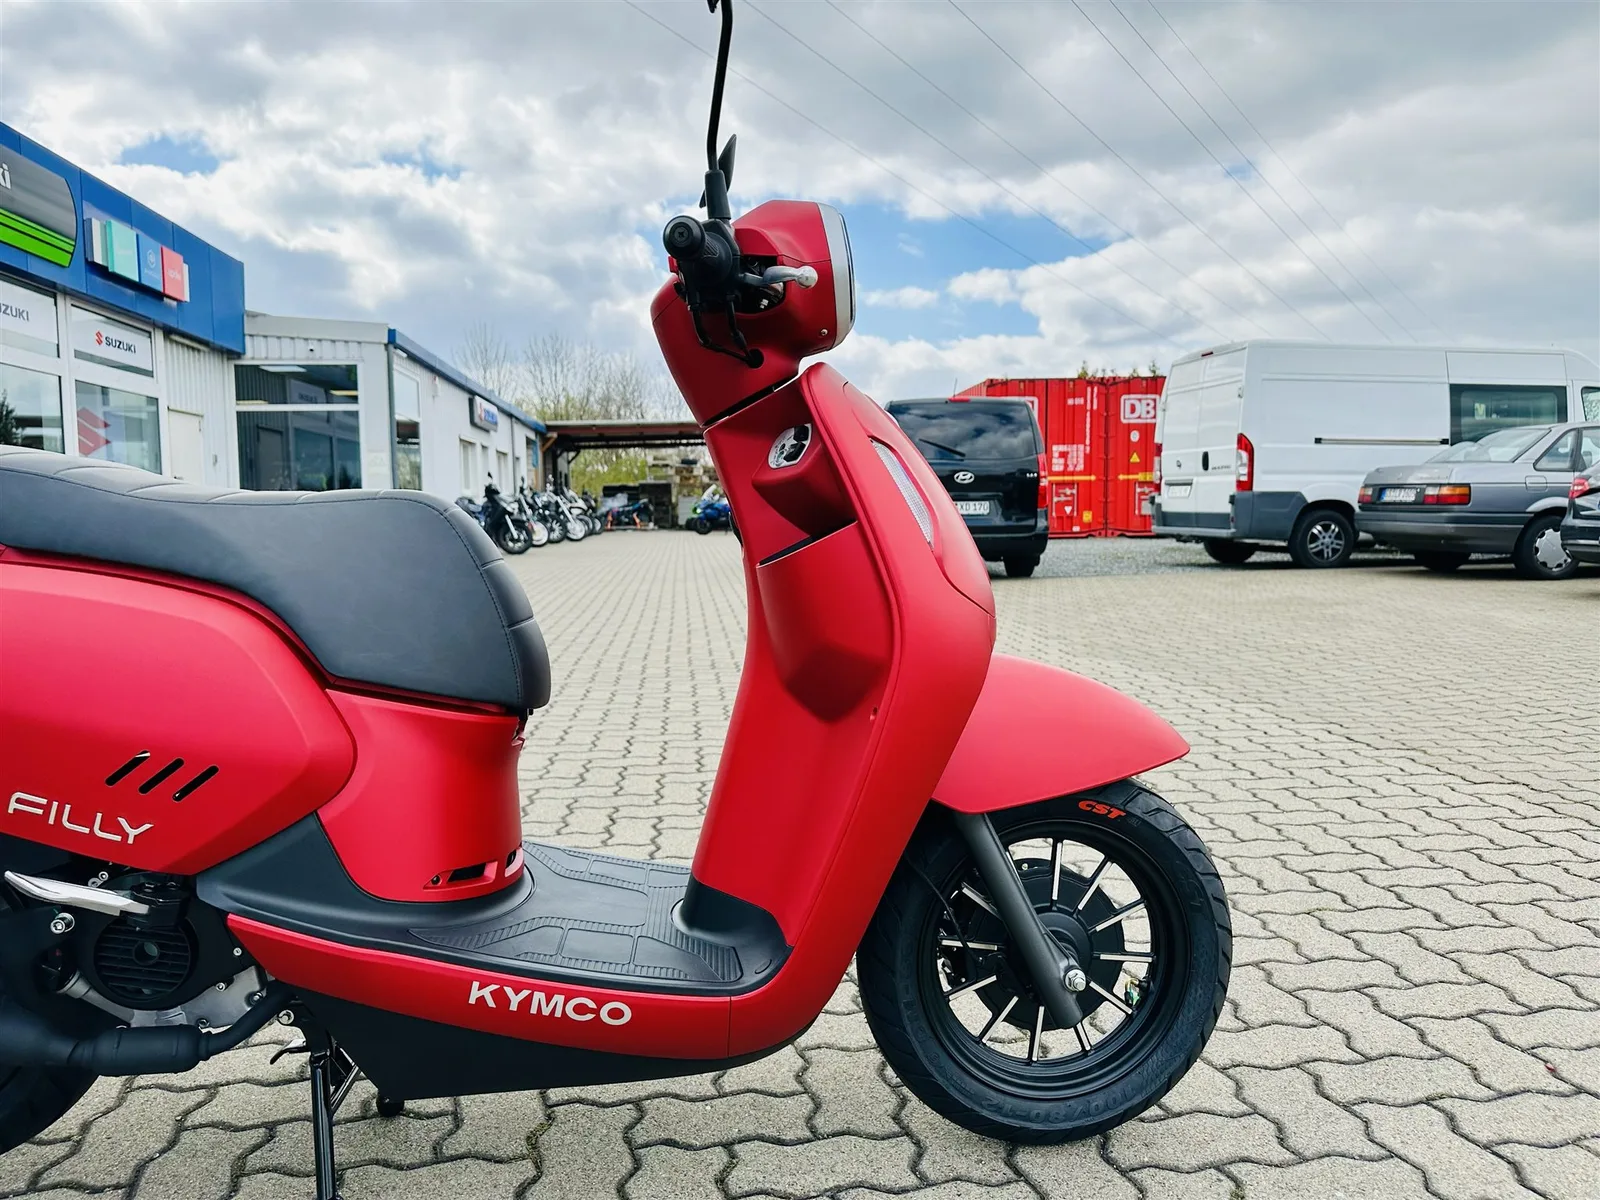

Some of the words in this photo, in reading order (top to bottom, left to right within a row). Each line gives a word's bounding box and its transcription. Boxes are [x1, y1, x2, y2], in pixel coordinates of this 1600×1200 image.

[0, 302, 29, 322] ZUKI
[105, 336, 136, 354] SUZUKI
[1124, 399, 1155, 420] DB
[973, 502, 988, 511] 170
[8, 792, 154, 844] FILLY
[1078, 800, 1127, 819] CST
[468, 981, 632, 1026] KYMCO
